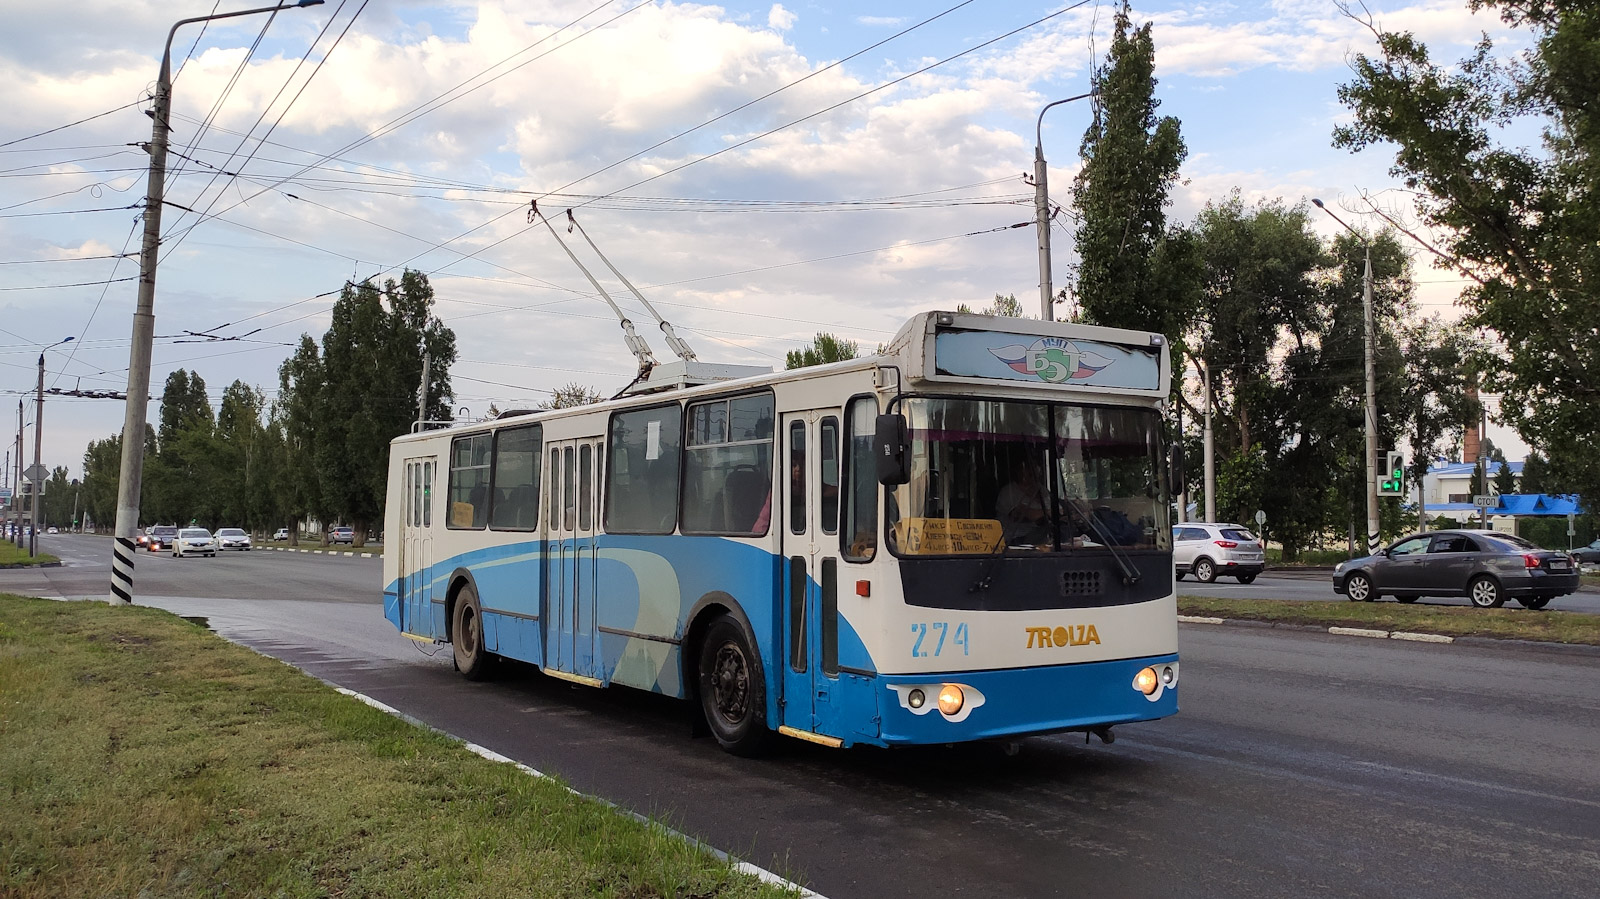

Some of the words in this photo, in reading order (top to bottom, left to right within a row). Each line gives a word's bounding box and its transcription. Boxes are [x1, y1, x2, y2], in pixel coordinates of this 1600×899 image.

[1042, 338, 1069, 350] МУП
[1477, 497, 1496, 506] СТОП
[911, 622, 969, 658] 274
[1025, 624, 1101, 649] TROLZA
